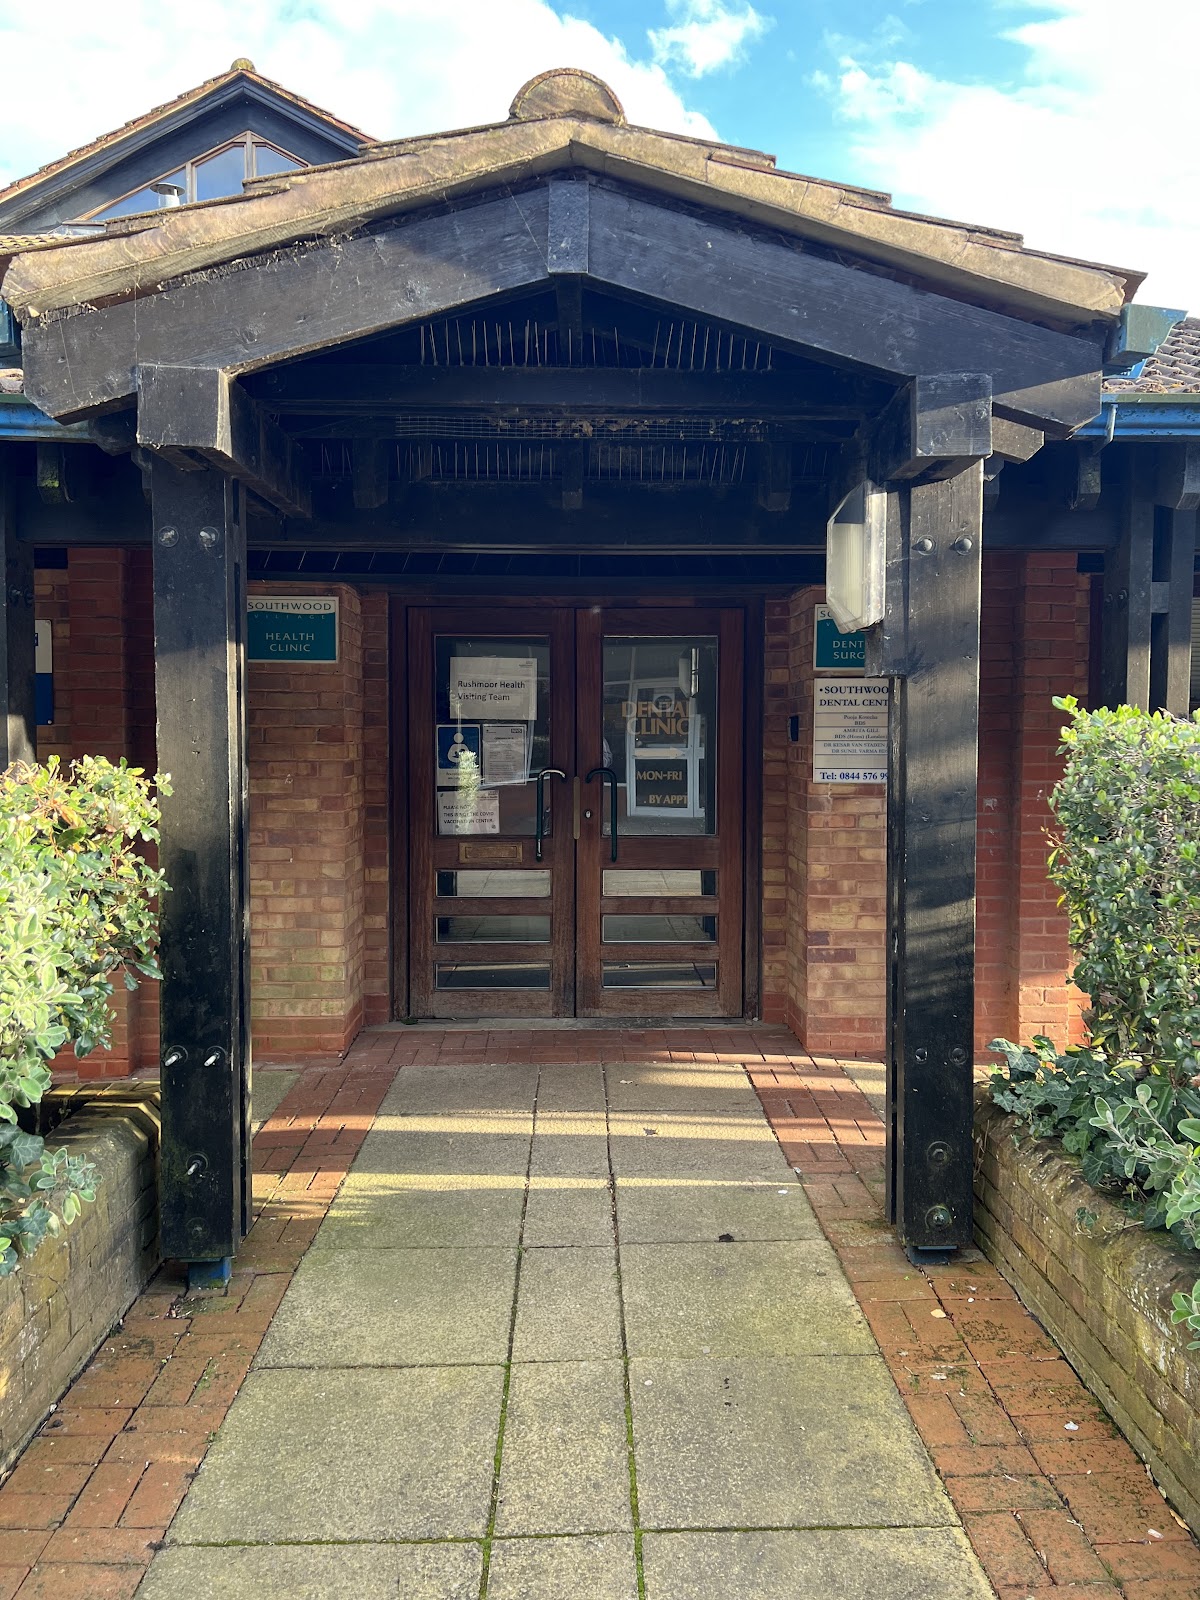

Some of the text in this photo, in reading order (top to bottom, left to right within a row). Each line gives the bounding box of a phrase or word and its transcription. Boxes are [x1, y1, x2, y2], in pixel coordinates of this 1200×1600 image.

[247, 602, 332, 611] SOUTHWOOD
[265, 632, 315, 641] HEALTH
[269, 643, 311, 652] CLINIC
[457, 680, 526, 689] Rushmoor Health
[457, 692, 510, 702] Visiting Team
[819, 698, 861, 707] DENTAL
[621, 701, 695, 718] DENTAL
[626, 718, 691, 735] CLINIC
[636, 770, 683, 781] MON-FRI
[819, 772, 837, 780] Tel:
[839, 772, 860, 780] 0844
[862, 772, 878, 780] 576
[648, 794, 688, 804] BY APPT
